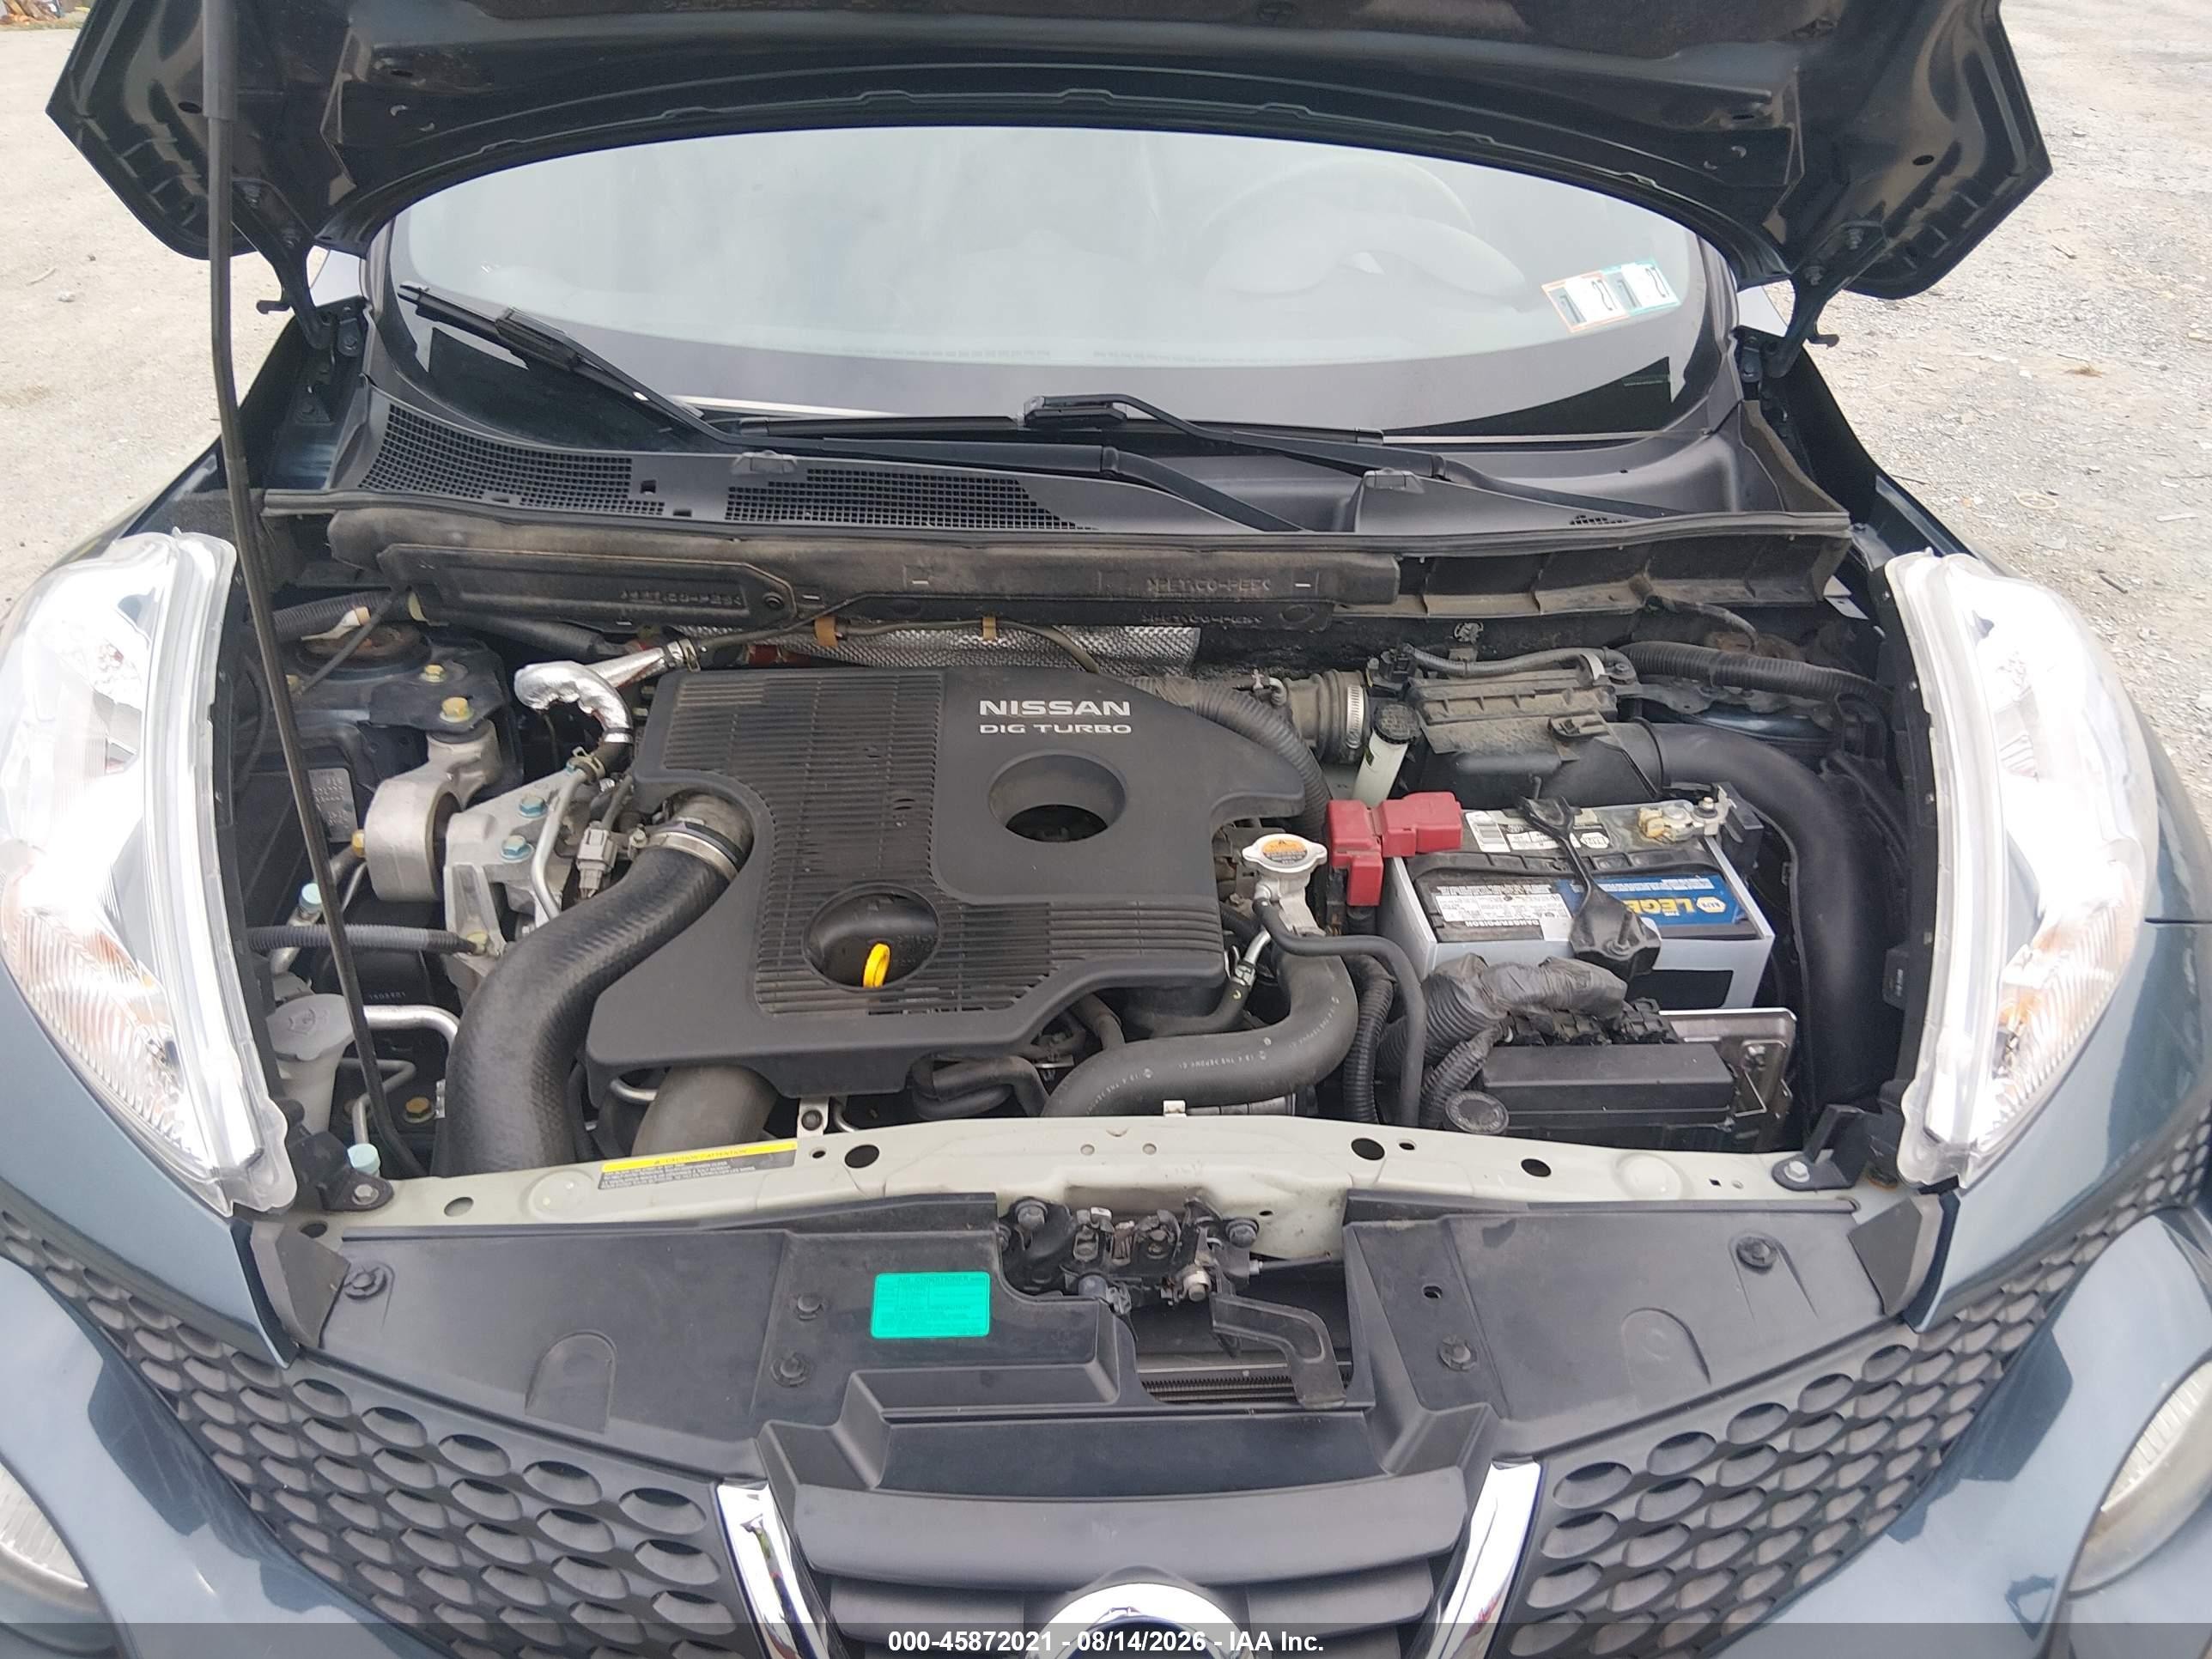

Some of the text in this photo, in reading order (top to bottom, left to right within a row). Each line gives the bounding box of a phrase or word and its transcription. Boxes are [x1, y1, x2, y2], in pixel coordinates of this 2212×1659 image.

[980, 700, 1131, 716] NISSAN
[980, 724, 1132, 734] DIG TURBO
